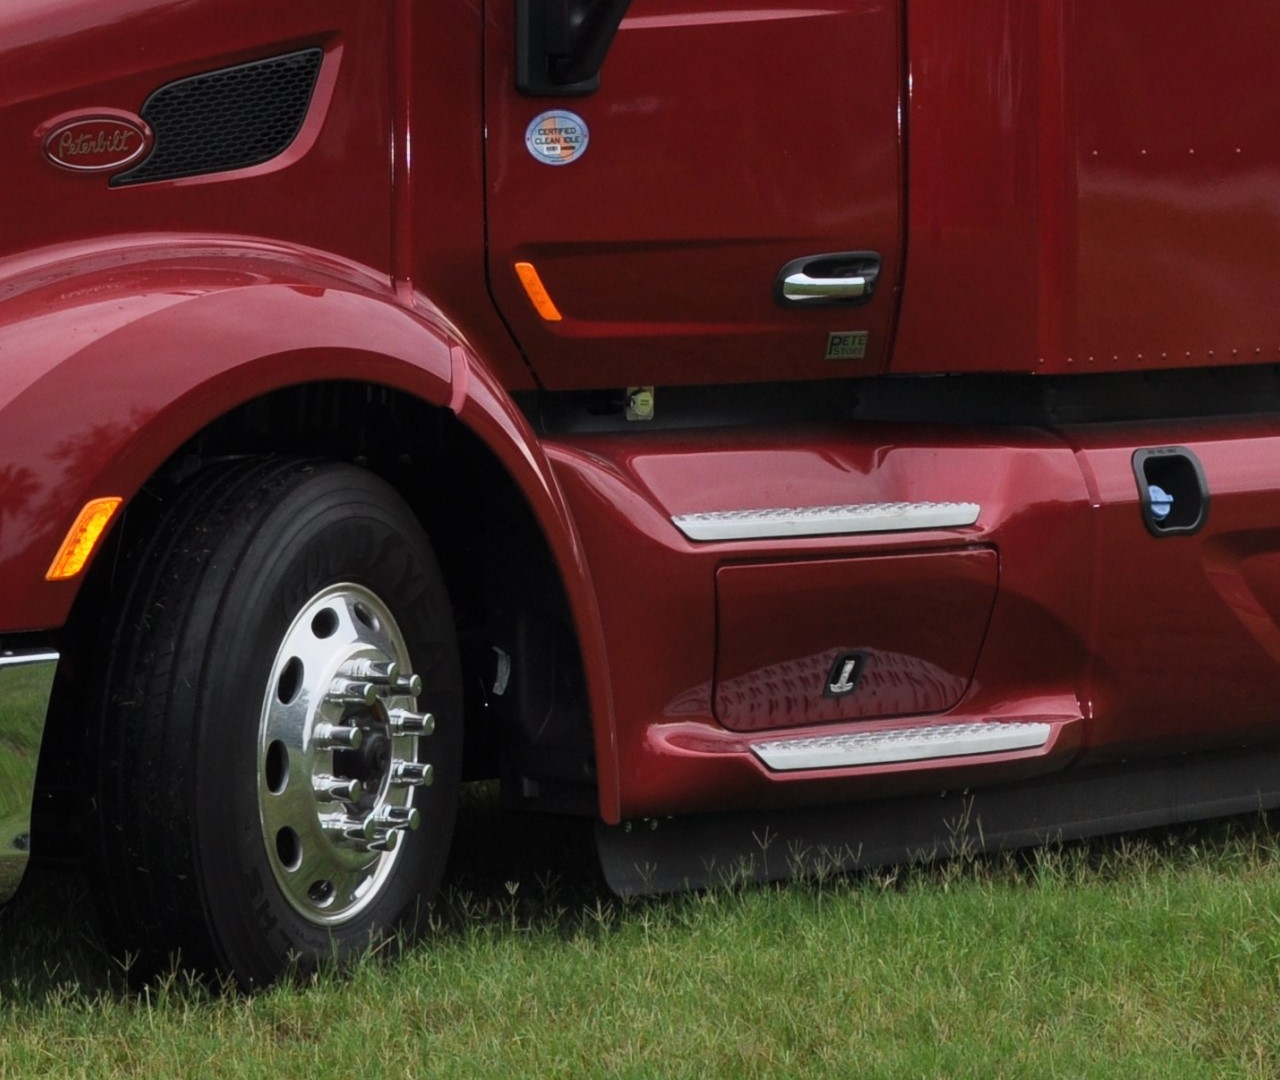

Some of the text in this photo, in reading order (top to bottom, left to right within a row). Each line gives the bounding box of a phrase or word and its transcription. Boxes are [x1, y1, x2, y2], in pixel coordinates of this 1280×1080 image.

[535, 137, 561, 146] CLEAN
[537, 127, 577, 136] CERTIFIED
[58, 130, 135, 158] Peterbilt
[828, 334, 866, 356] PETE
[282, 524, 459, 736] GOODYEAR
